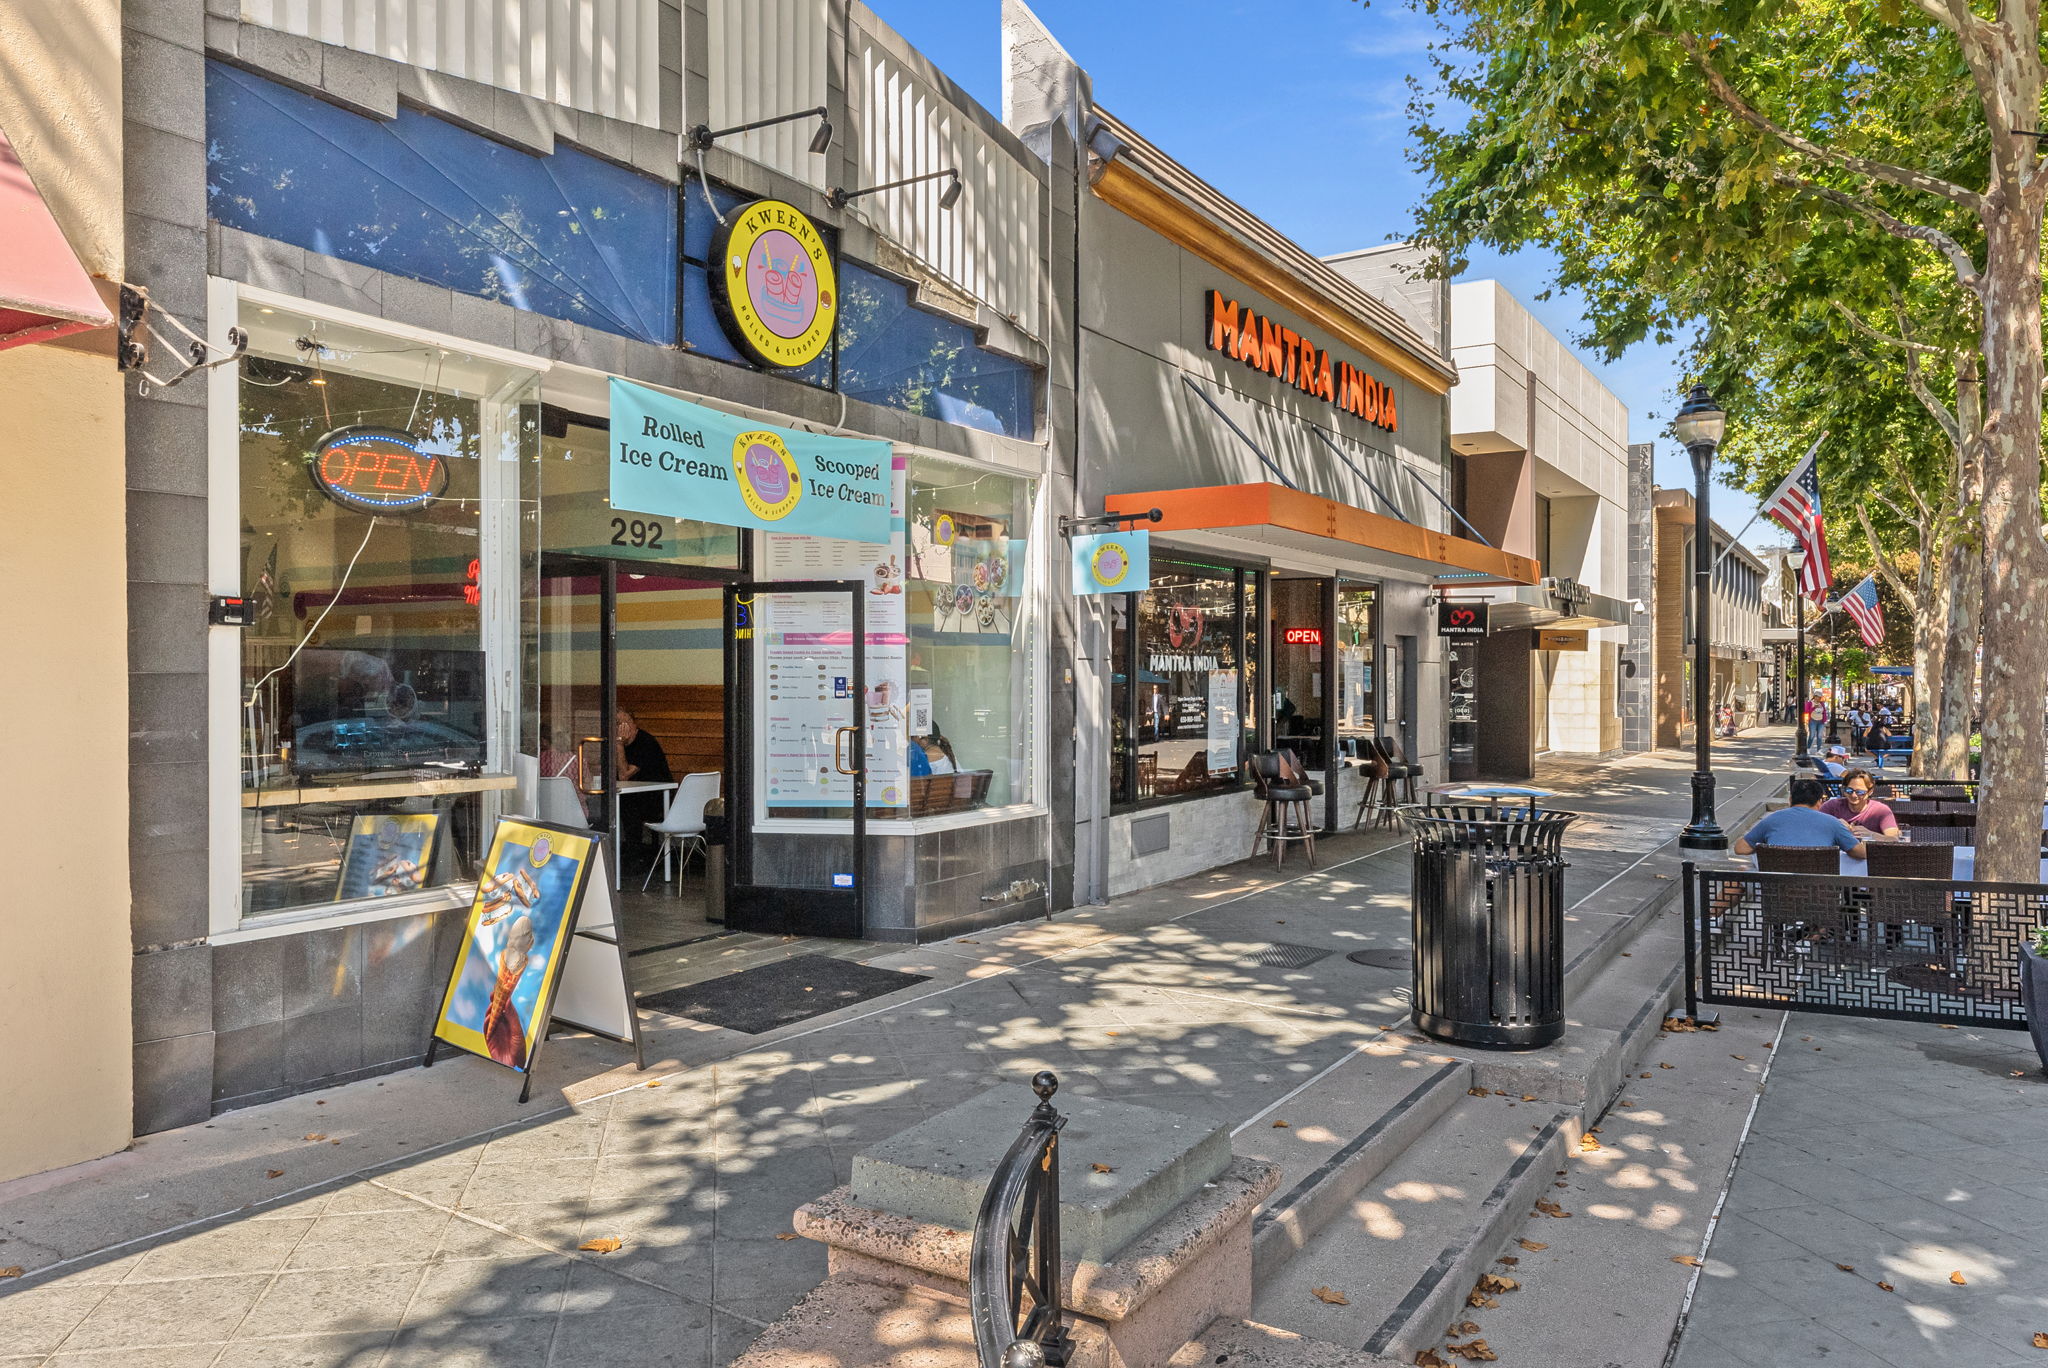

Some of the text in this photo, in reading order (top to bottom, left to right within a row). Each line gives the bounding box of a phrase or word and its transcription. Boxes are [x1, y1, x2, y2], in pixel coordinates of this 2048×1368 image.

[746, 209, 822, 260] KWEEN'S
[741, 305, 770, 347] ROLLED
[786, 329, 821, 356] SCOOPED
[1211, 289, 1398, 432] MANTRA INDIA
[641, 415, 705, 449] Rolled
[321, 448, 438, 492] OPEN
[619, 442, 729, 481] Ice Cream
[814, 454, 880, 481] Scooped
[808, 478, 886, 507] Ice Cream
[610, 517, 664, 550] 292
[1286, 630, 1319, 642] OPEN
[1150, 654, 1219, 672] MANTRA INDIA
